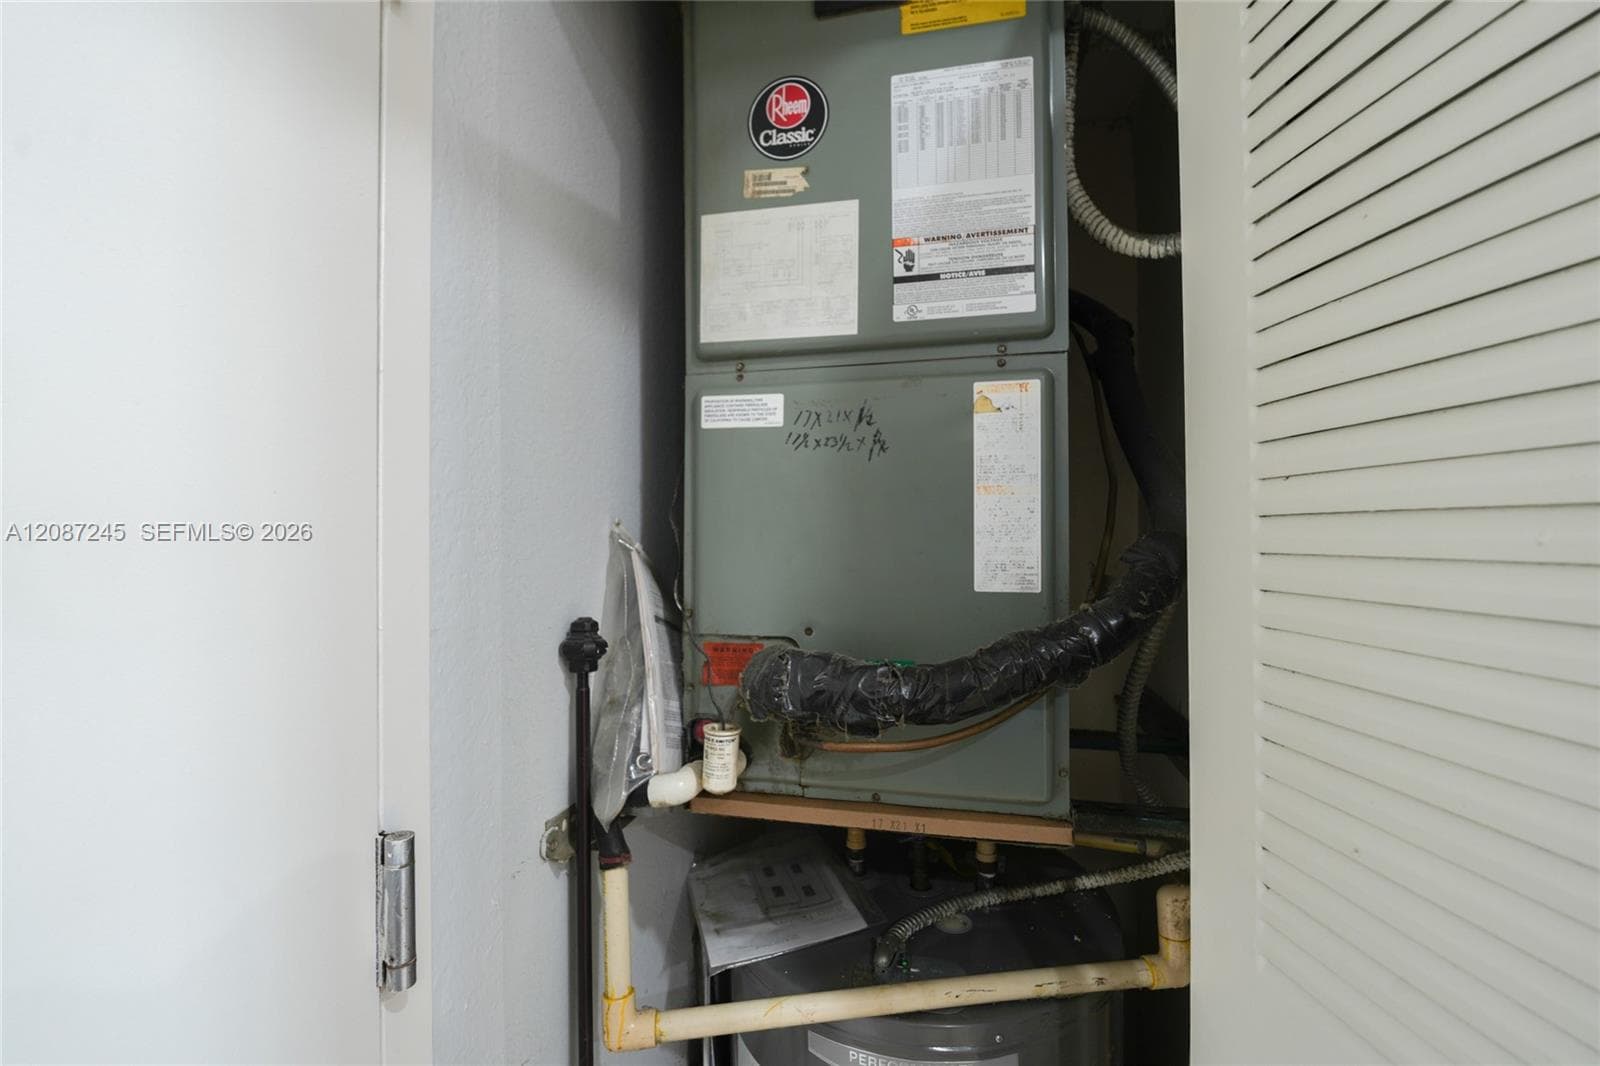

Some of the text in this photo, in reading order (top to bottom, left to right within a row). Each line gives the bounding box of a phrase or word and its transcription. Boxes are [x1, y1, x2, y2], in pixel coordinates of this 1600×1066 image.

[771, 85, 807, 122] Rheem
[759, 127, 815, 147] Classic
[924, 227, 1029, 242] WARNING AVERTISSEMENT
[940, 270, 986, 280] NOTICE/AVIS
[872, 818, 884, 829] 17
[915, 822, 926, 833] X1
